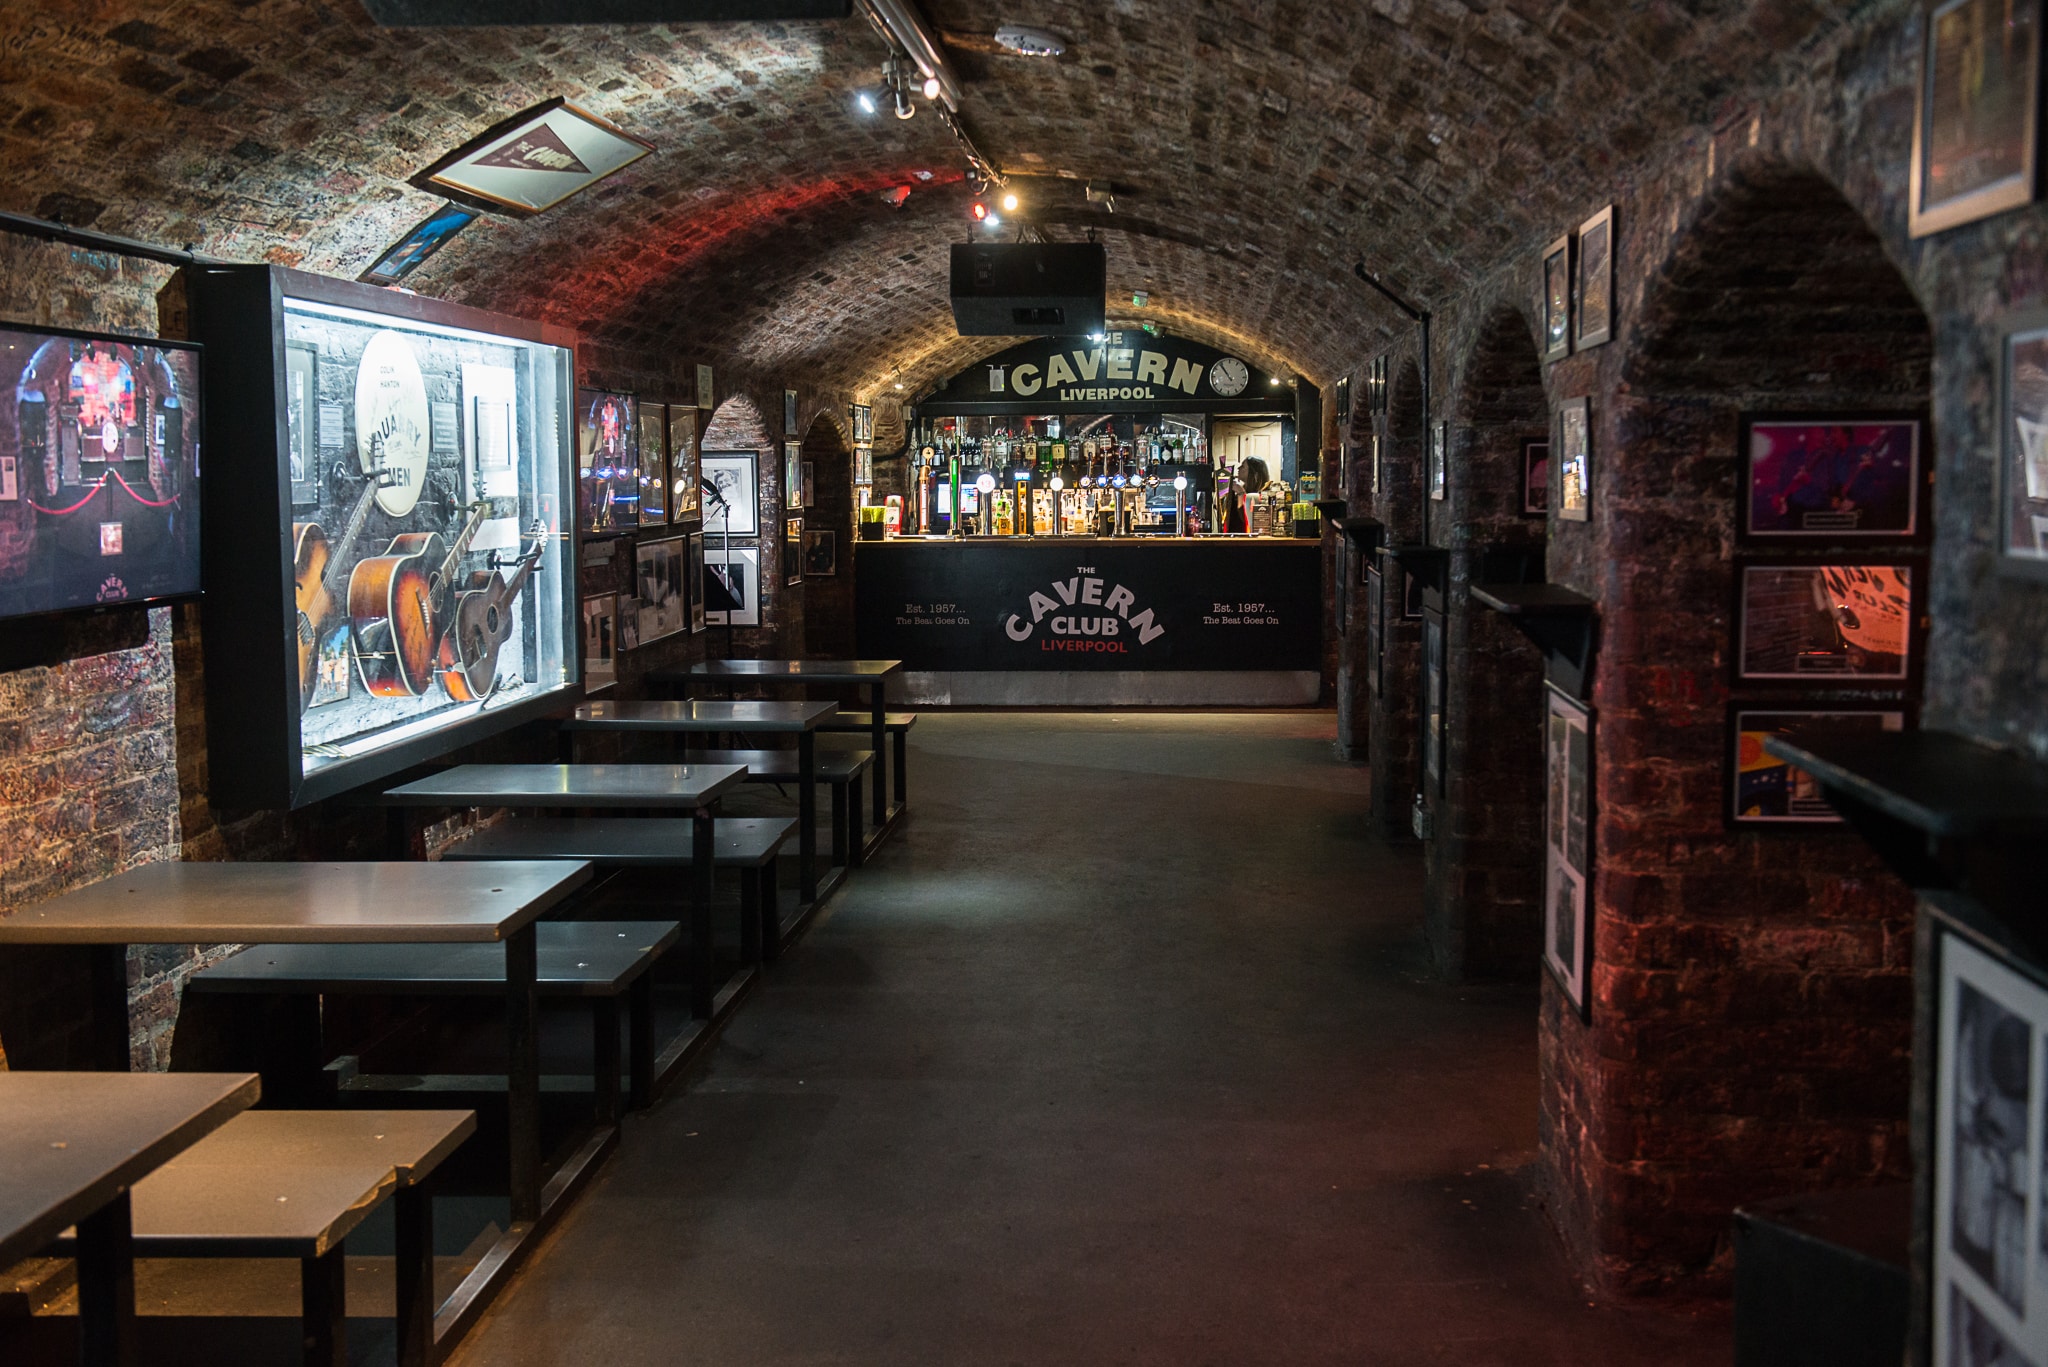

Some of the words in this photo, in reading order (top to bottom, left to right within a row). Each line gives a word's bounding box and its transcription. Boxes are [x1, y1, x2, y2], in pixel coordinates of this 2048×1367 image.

[1011, 348, 1204, 396] CAVERN
[1060, 387, 1155, 401] LIVERPOOL
[1077, 566, 1096, 574] THE
[905, 603, 926, 613] Est.
[1005, 576, 1165, 646] CAVERN
[1213, 603, 1234, 613] Est.
[1238, 603, 1275, 613] 1957...
[896, 617, 912, 625] The
[935, 617, 956, 625] Goes
[957, 617, 970, 625] On
[1050, 616, 1119, 636] CLUB
[1203, 616, 1220, 624] The
[1221, 616, 1242, 624] Beat
[1243, 616, 1264, 624] Goes
[1266, 616, 1279, 624] On
[1041, 639, 1129, 653] LIVERPOOL
